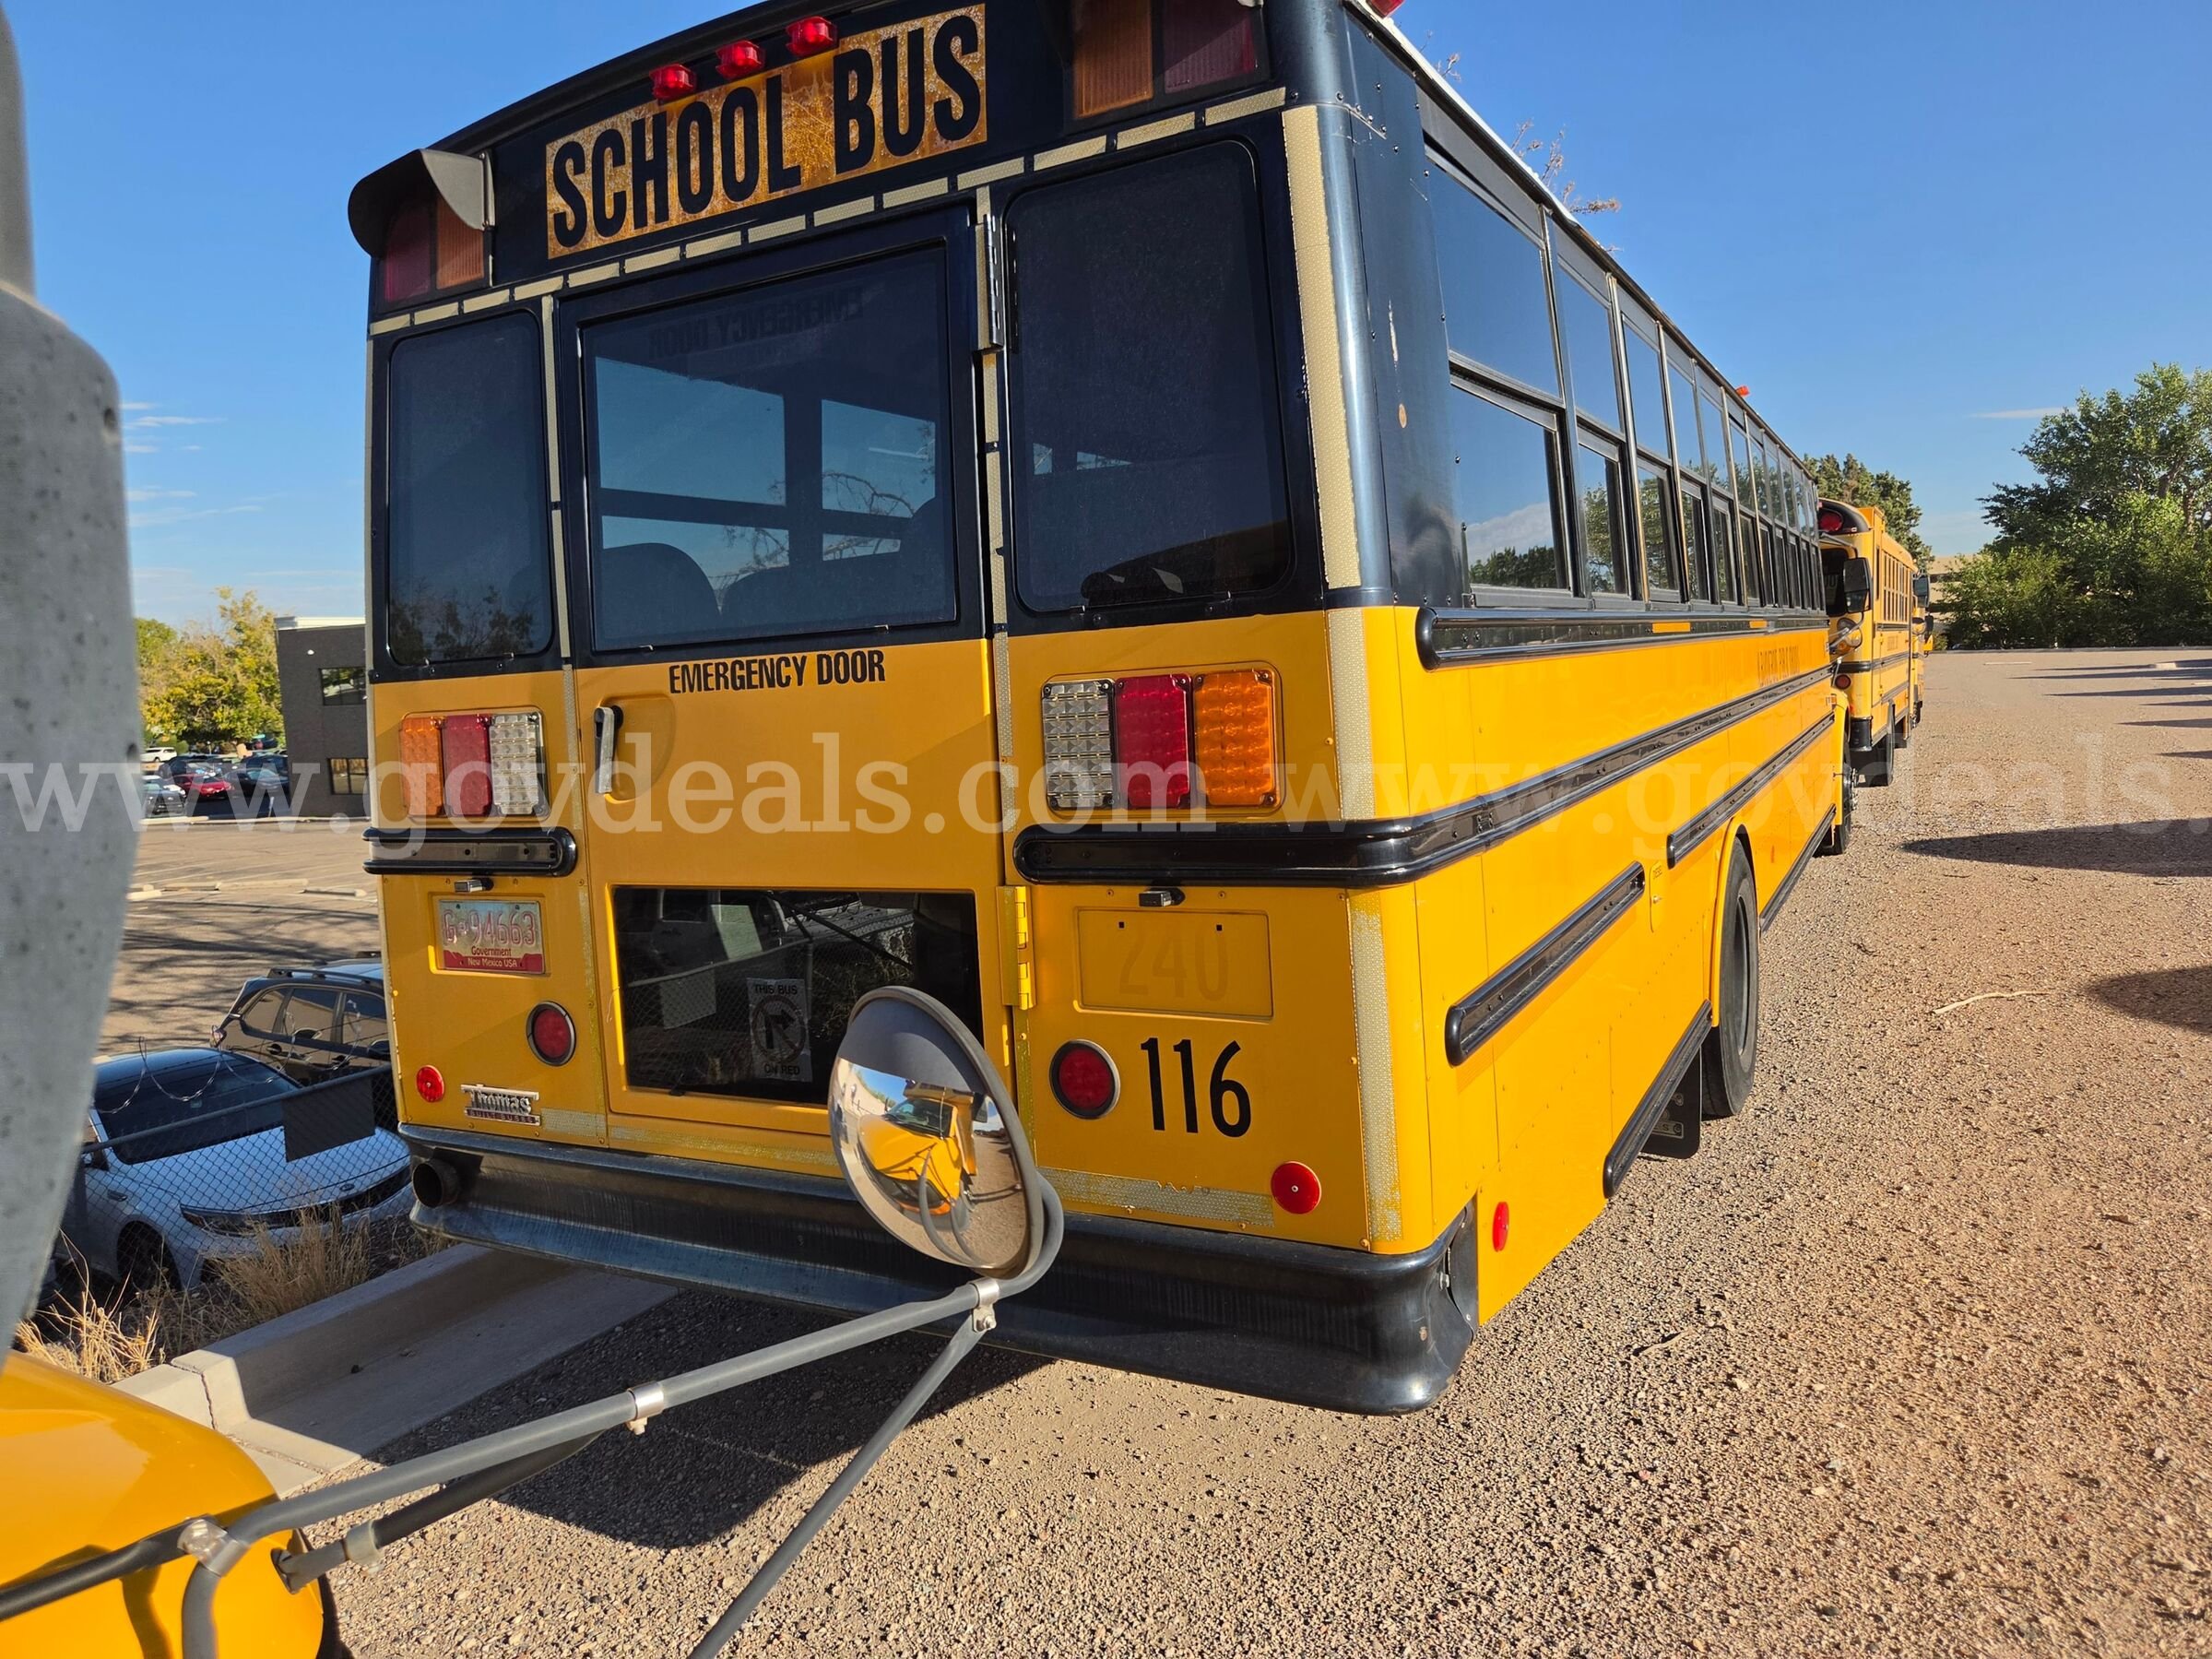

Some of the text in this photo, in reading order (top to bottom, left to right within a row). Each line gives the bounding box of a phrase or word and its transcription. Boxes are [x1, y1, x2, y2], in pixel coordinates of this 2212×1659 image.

[552, 15, 980, 248] SCHOOL BUS
[668, 649, 886, 694] EMERGENCY DOOR
[471, 945, 512, 957] Government
[467, 957, 517, 968] New Mexico USA
[754, 984, 798, 995] THIS BUS
[763, 1063, 801, 1076] ON RED
[1140, 1037, 1252, 1139] 116
[461, 1084, 539, 1116] Thomas
